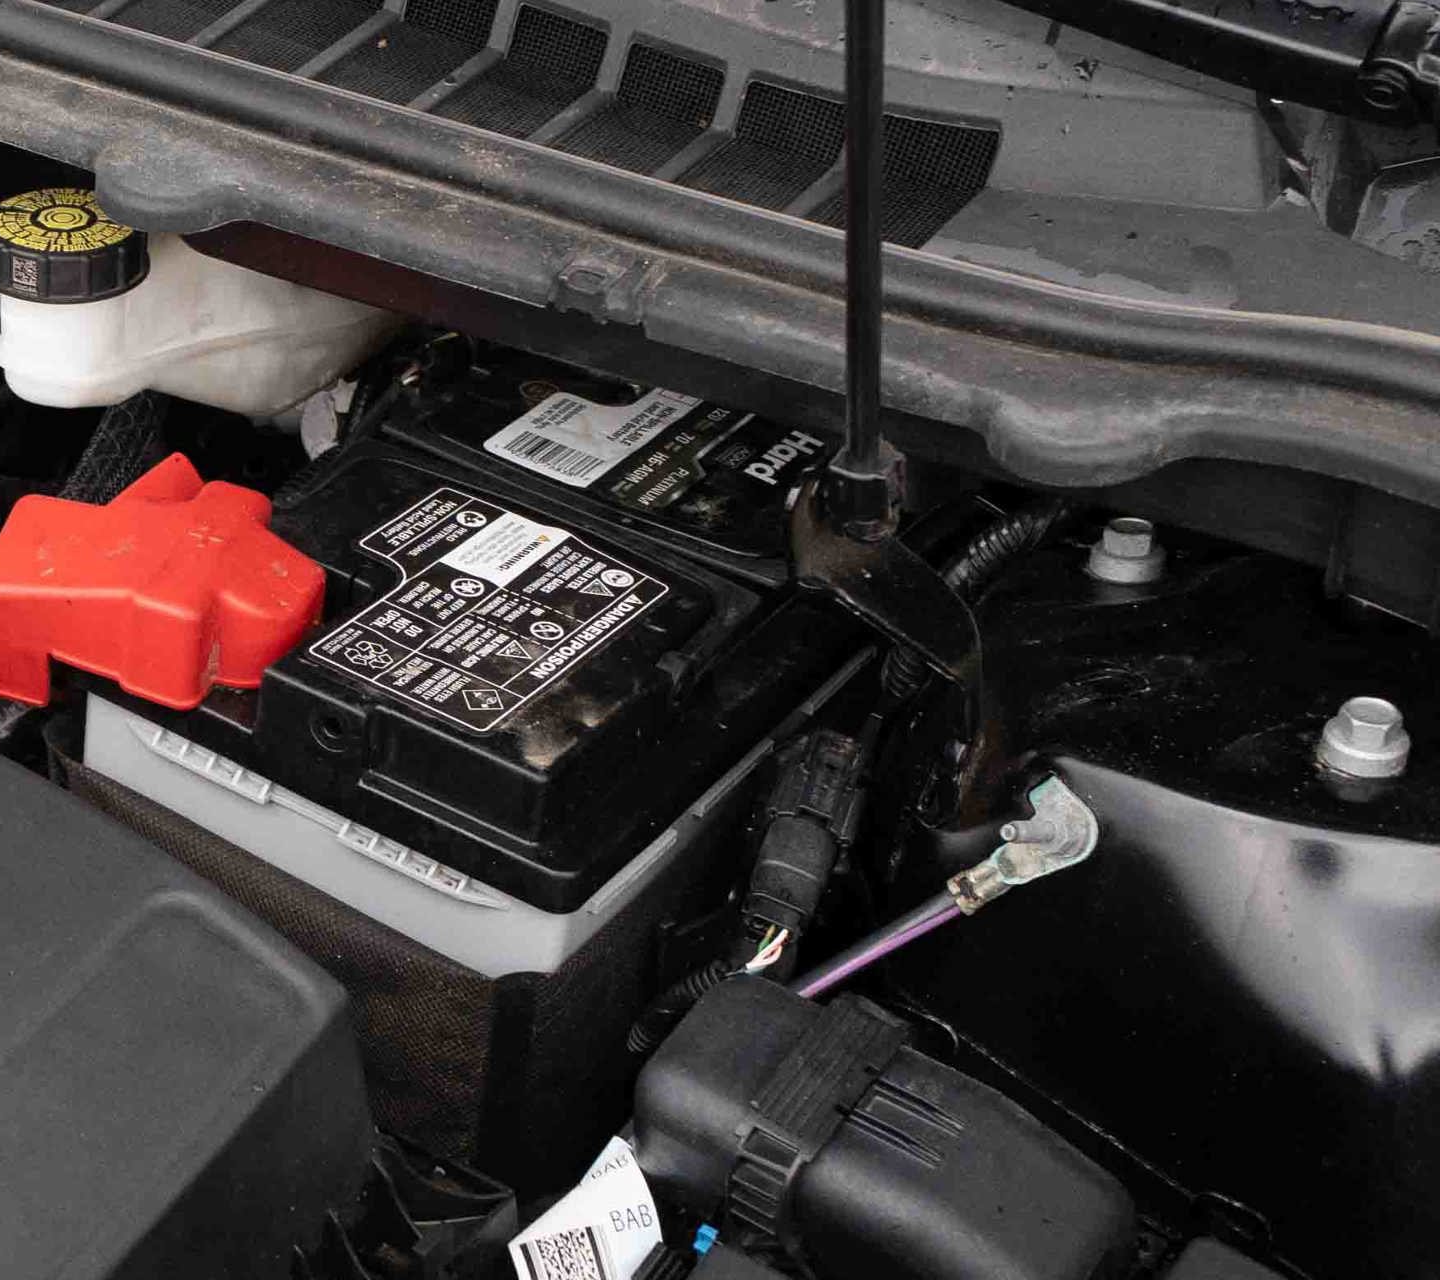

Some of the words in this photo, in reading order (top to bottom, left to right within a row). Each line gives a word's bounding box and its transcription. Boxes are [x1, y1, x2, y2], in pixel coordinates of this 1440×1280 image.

[629, 412, 650, 424] Acid
[604, 422, 637, 441] Battery
[671, 432, 696, 444] 70
[740, 430, 828, 485] Hard
[622, 451, 670, 483] H6-AGM
[634, 466, 691, 506] PLATINUM
[386, 500, 457, 546] NON-SPILLABLE
[404, 509, 425, 523] Acid
[445, 526, 467, 542] READ
[368, 608, 401, 630] OPEN.
[386, 616, 412, 632] NOT
[402, 625, 423, 637] DO
[479, 628, 497, 639] CAN
[528, 601, 634, 679] DANGER/POISON
[459, 654, 482, 668] ACID
[610, 1205, 654, 1232] BAB
